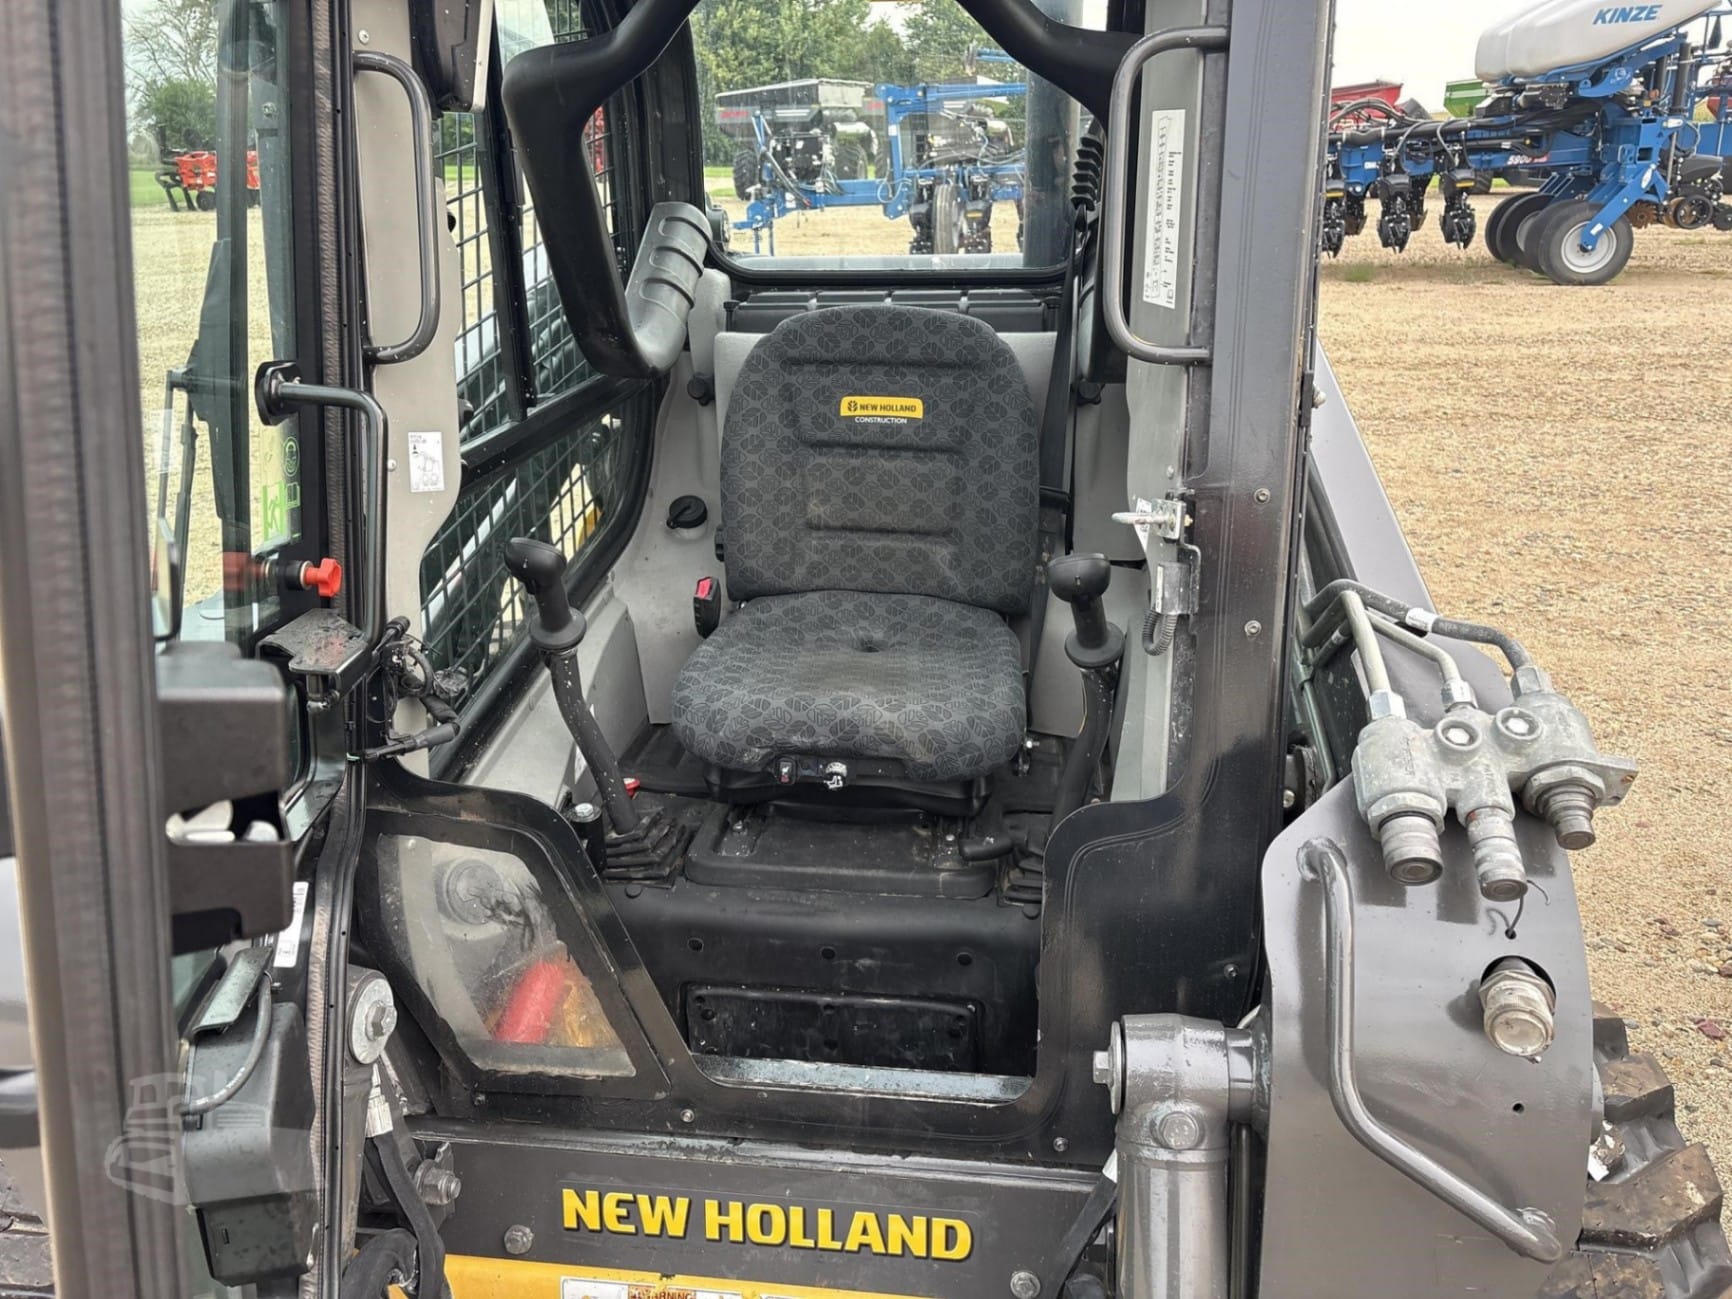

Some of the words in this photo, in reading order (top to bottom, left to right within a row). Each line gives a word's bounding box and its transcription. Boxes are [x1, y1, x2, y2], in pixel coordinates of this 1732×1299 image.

[1592, 5, 1663, 25] KINZE
[860, 403, 878, 412] NEW
[880, 404, 917, 413] HOLLAND
[854, 416, 908, 424] CONSTRUCTION
[562, 1188, 690, 1238] NEW
[704, 1199, 973, 1261] HOLLAND
